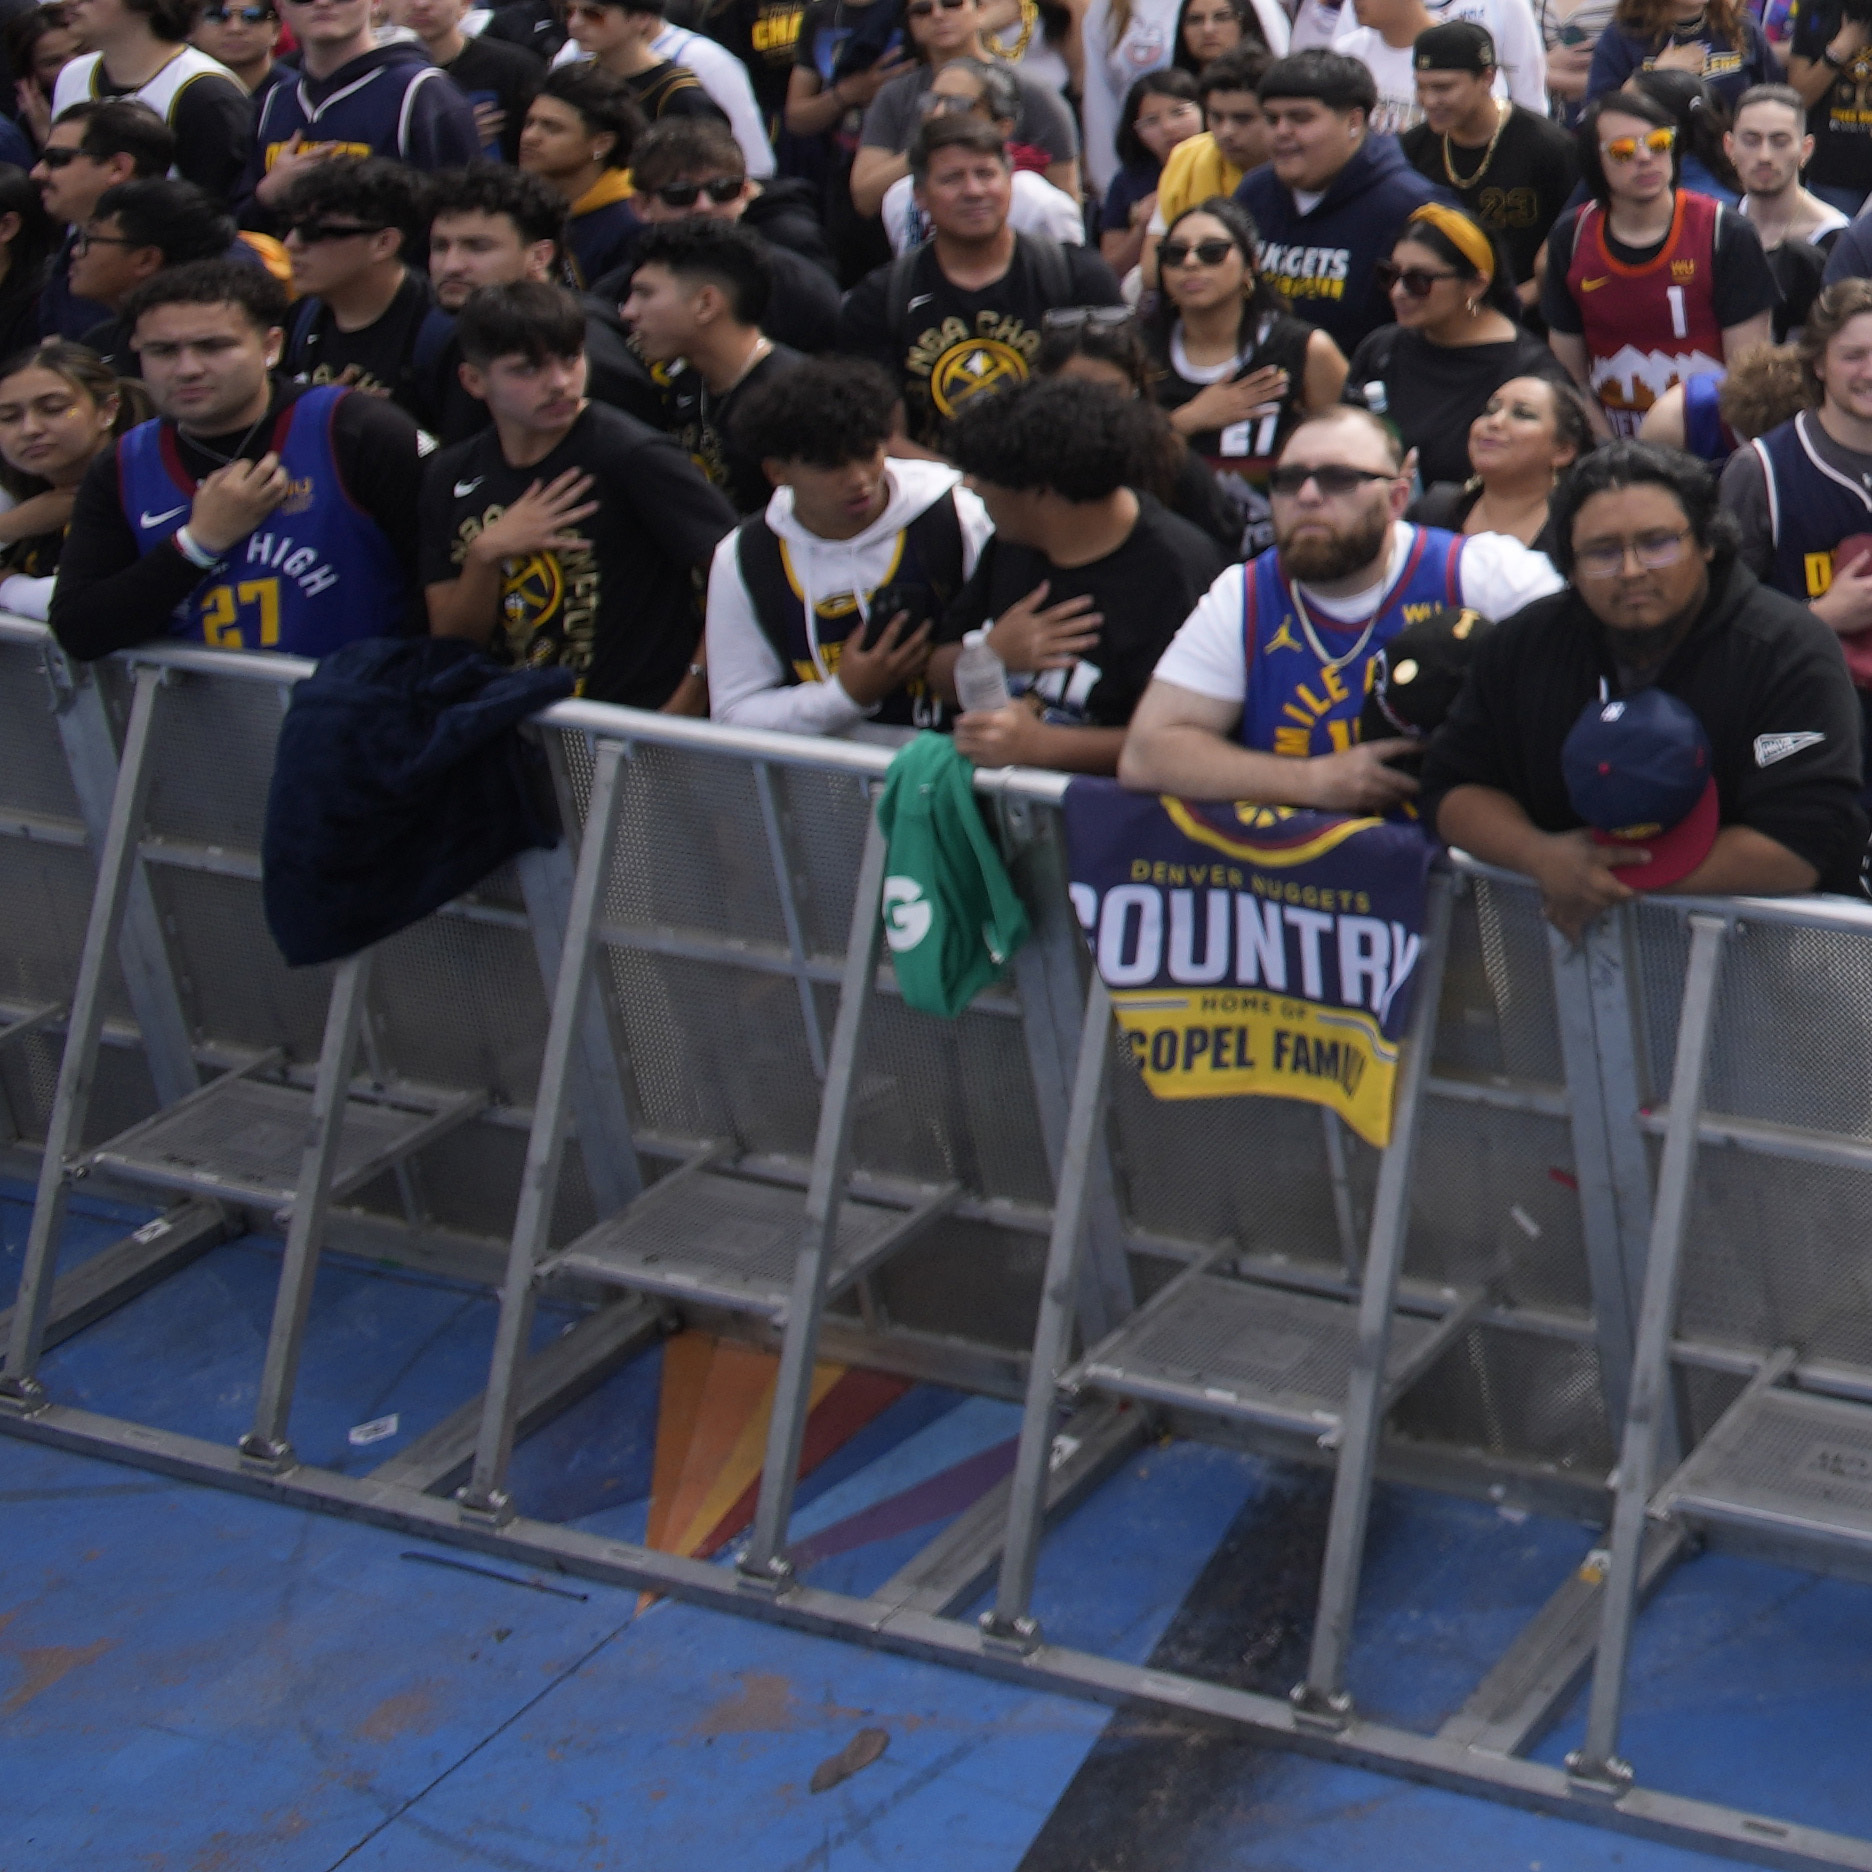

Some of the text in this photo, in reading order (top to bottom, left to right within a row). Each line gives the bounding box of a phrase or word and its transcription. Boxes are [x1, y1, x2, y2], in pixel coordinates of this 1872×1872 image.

[1666, 285, 1688, 339] 1
[906, 315, 963, 376] NBA
[244, 530, 340, 600] HIGH
[202, 575, 280, 649] 27
[1131, 859, 1371, 915] DENVER NUGGETS
[1200, 995, 1272, 1018] HOME
